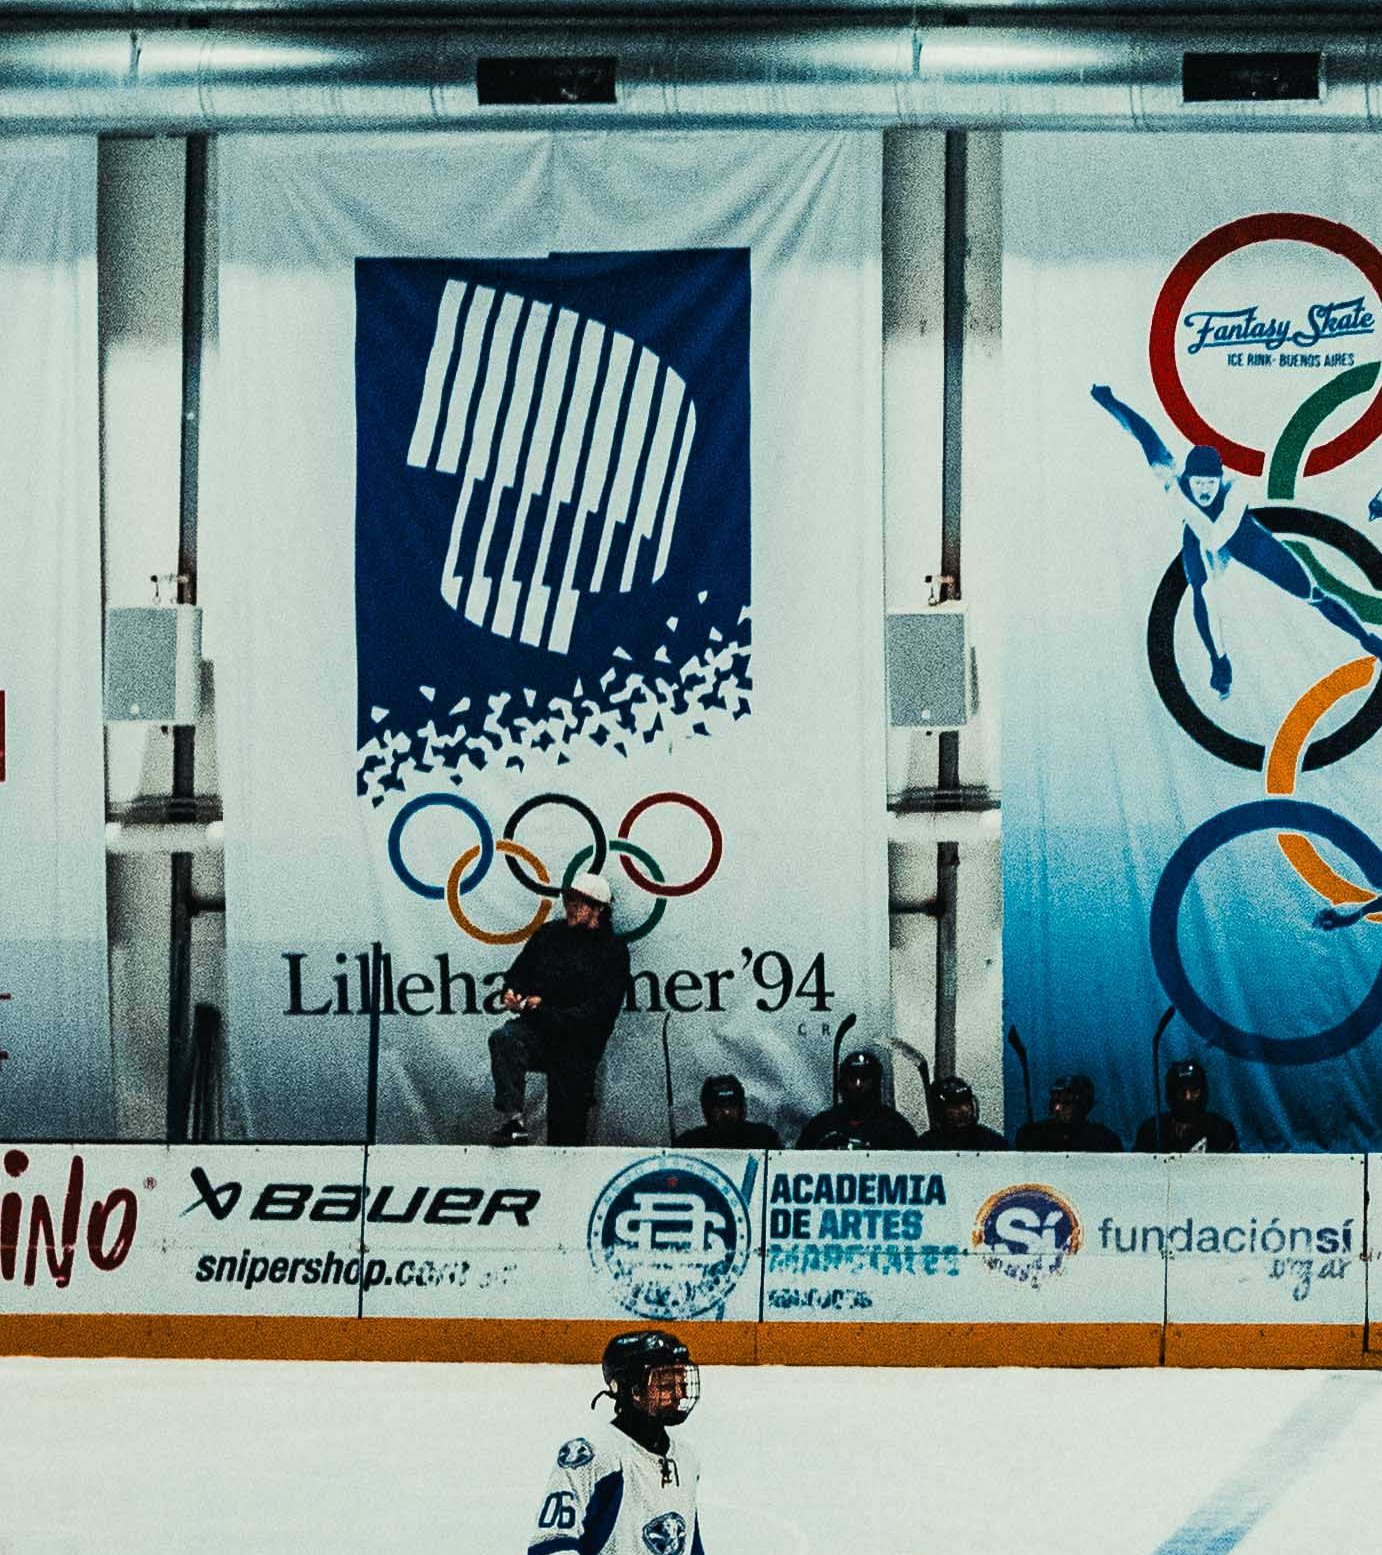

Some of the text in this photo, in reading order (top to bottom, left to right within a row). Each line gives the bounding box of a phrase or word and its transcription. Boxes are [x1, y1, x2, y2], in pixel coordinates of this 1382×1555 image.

[1184, 295, 1375, 354] Fantasy Skate
[1227, 353, 1243, 366] ICE
[1279, 353, 1321, 367] BUENOS
[1324, 353, 1355, 367] AIRES
[770, 1173, 947, 1206] ACADEMIA
[770, 1207, 924, 1241] DE ARTES
[538, 1491, 577, 1530] 06
